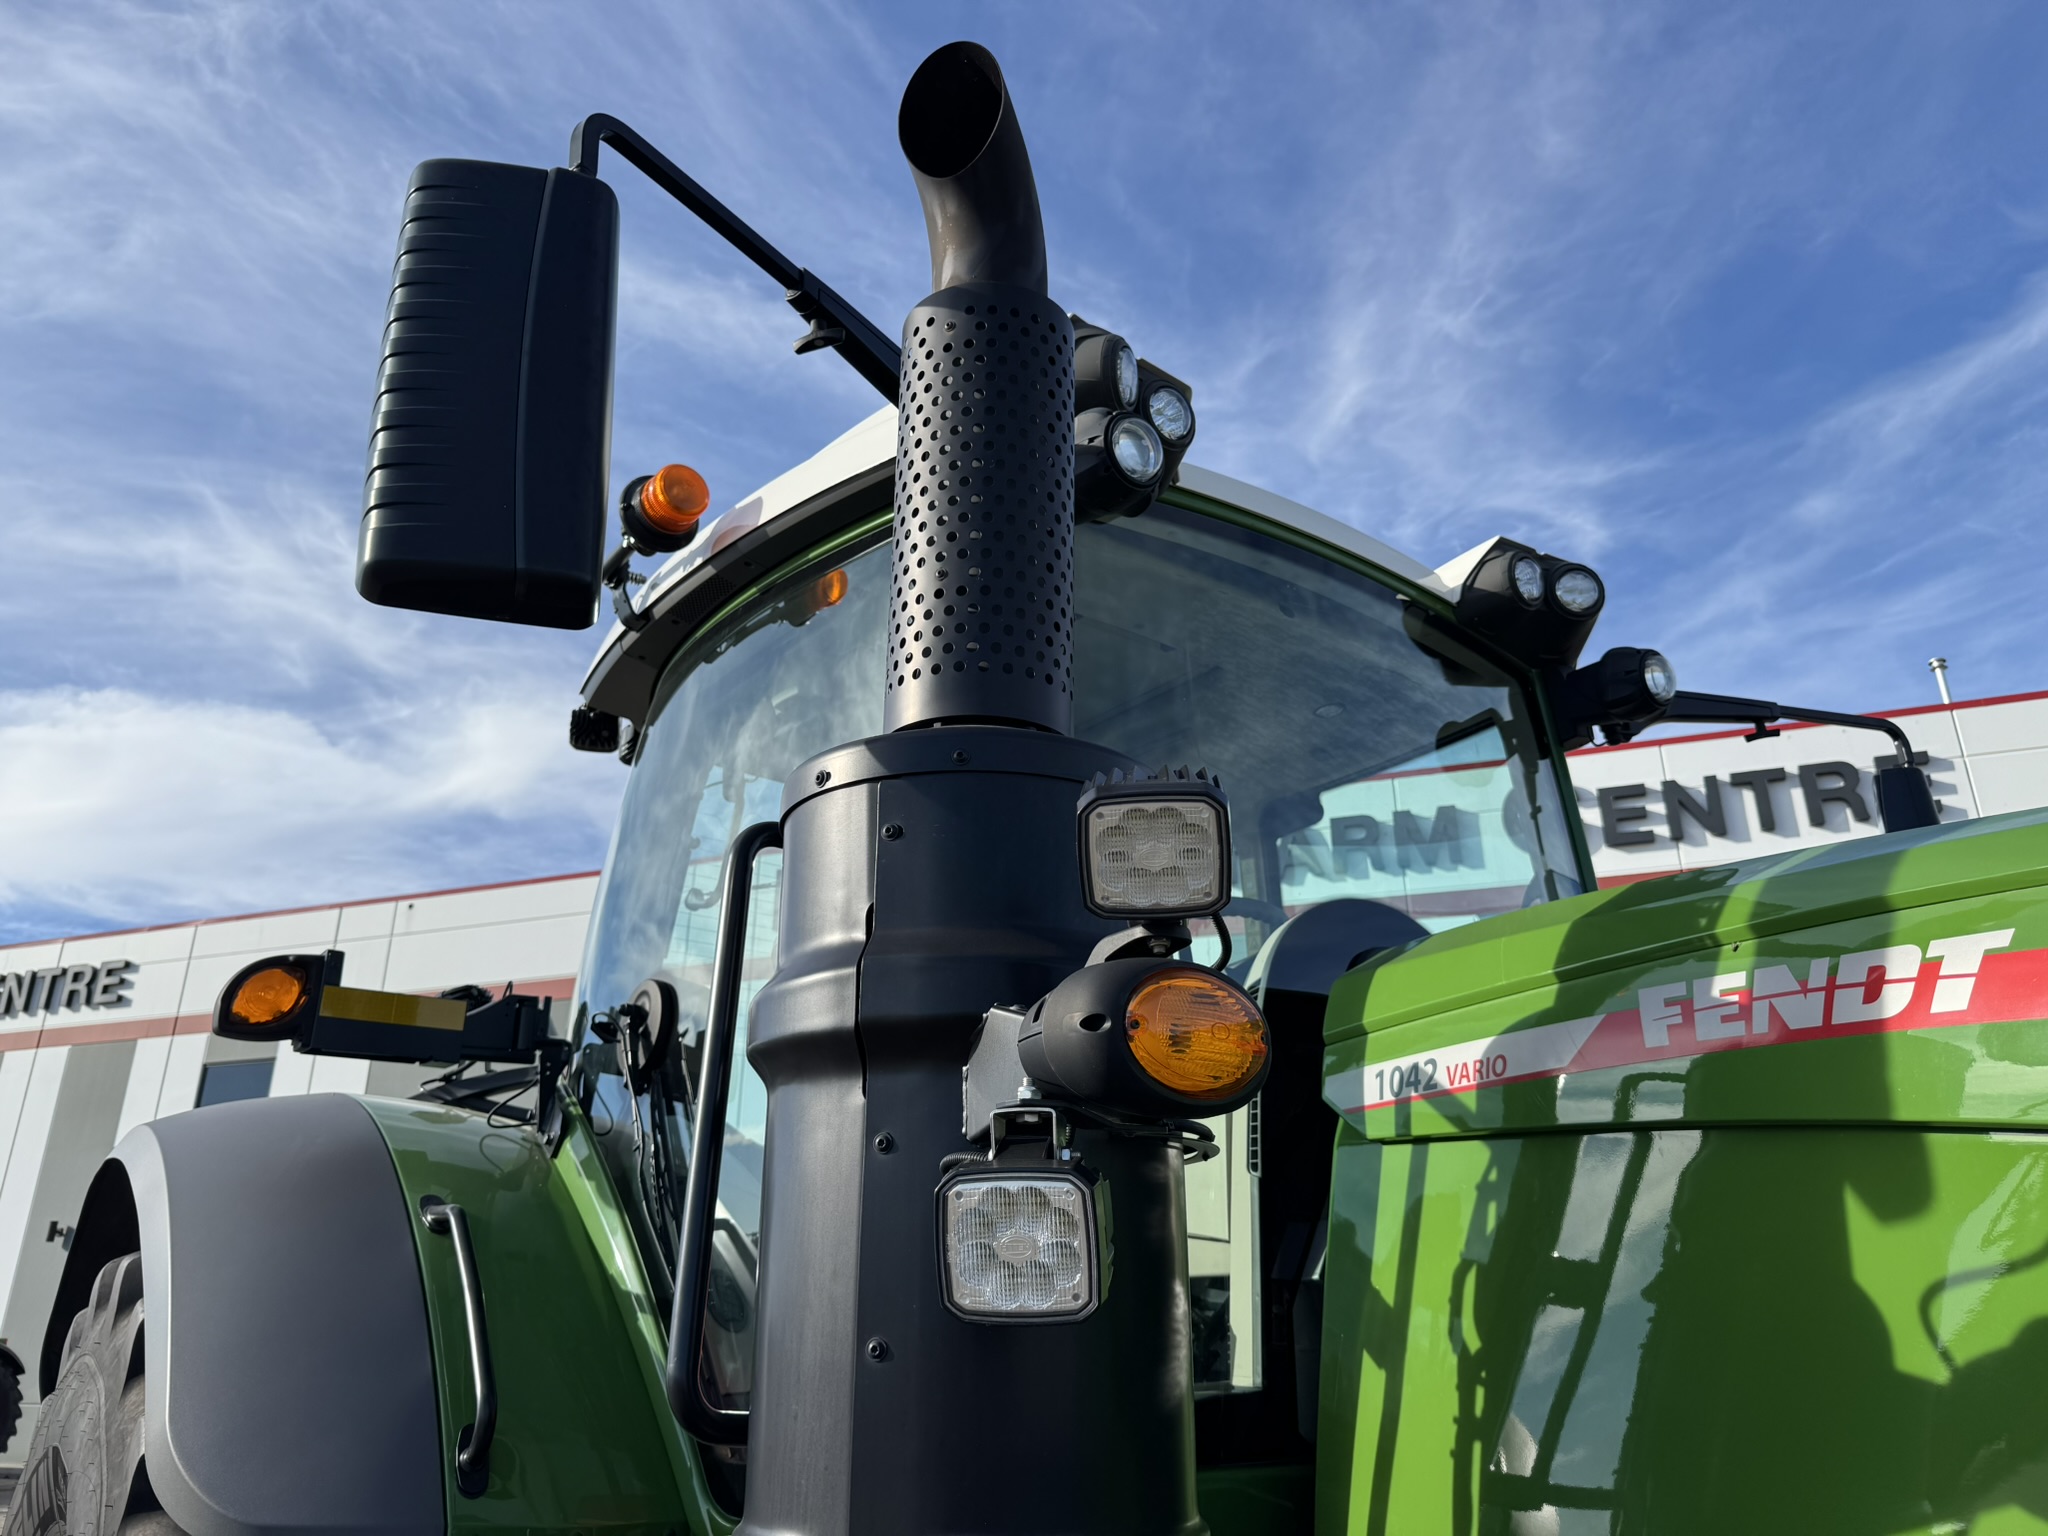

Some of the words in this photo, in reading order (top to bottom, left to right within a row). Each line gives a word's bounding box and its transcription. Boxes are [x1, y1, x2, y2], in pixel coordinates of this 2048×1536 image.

[1576, 750, 1943, 847] ENTR
[0, 960, 130, 1014] NTRE
[1638, 928, 2015, 1047] FENDT
[1375, 1058, 1438, 1100] 1042
[1446, 1054, 1507, 1087] VARIO
